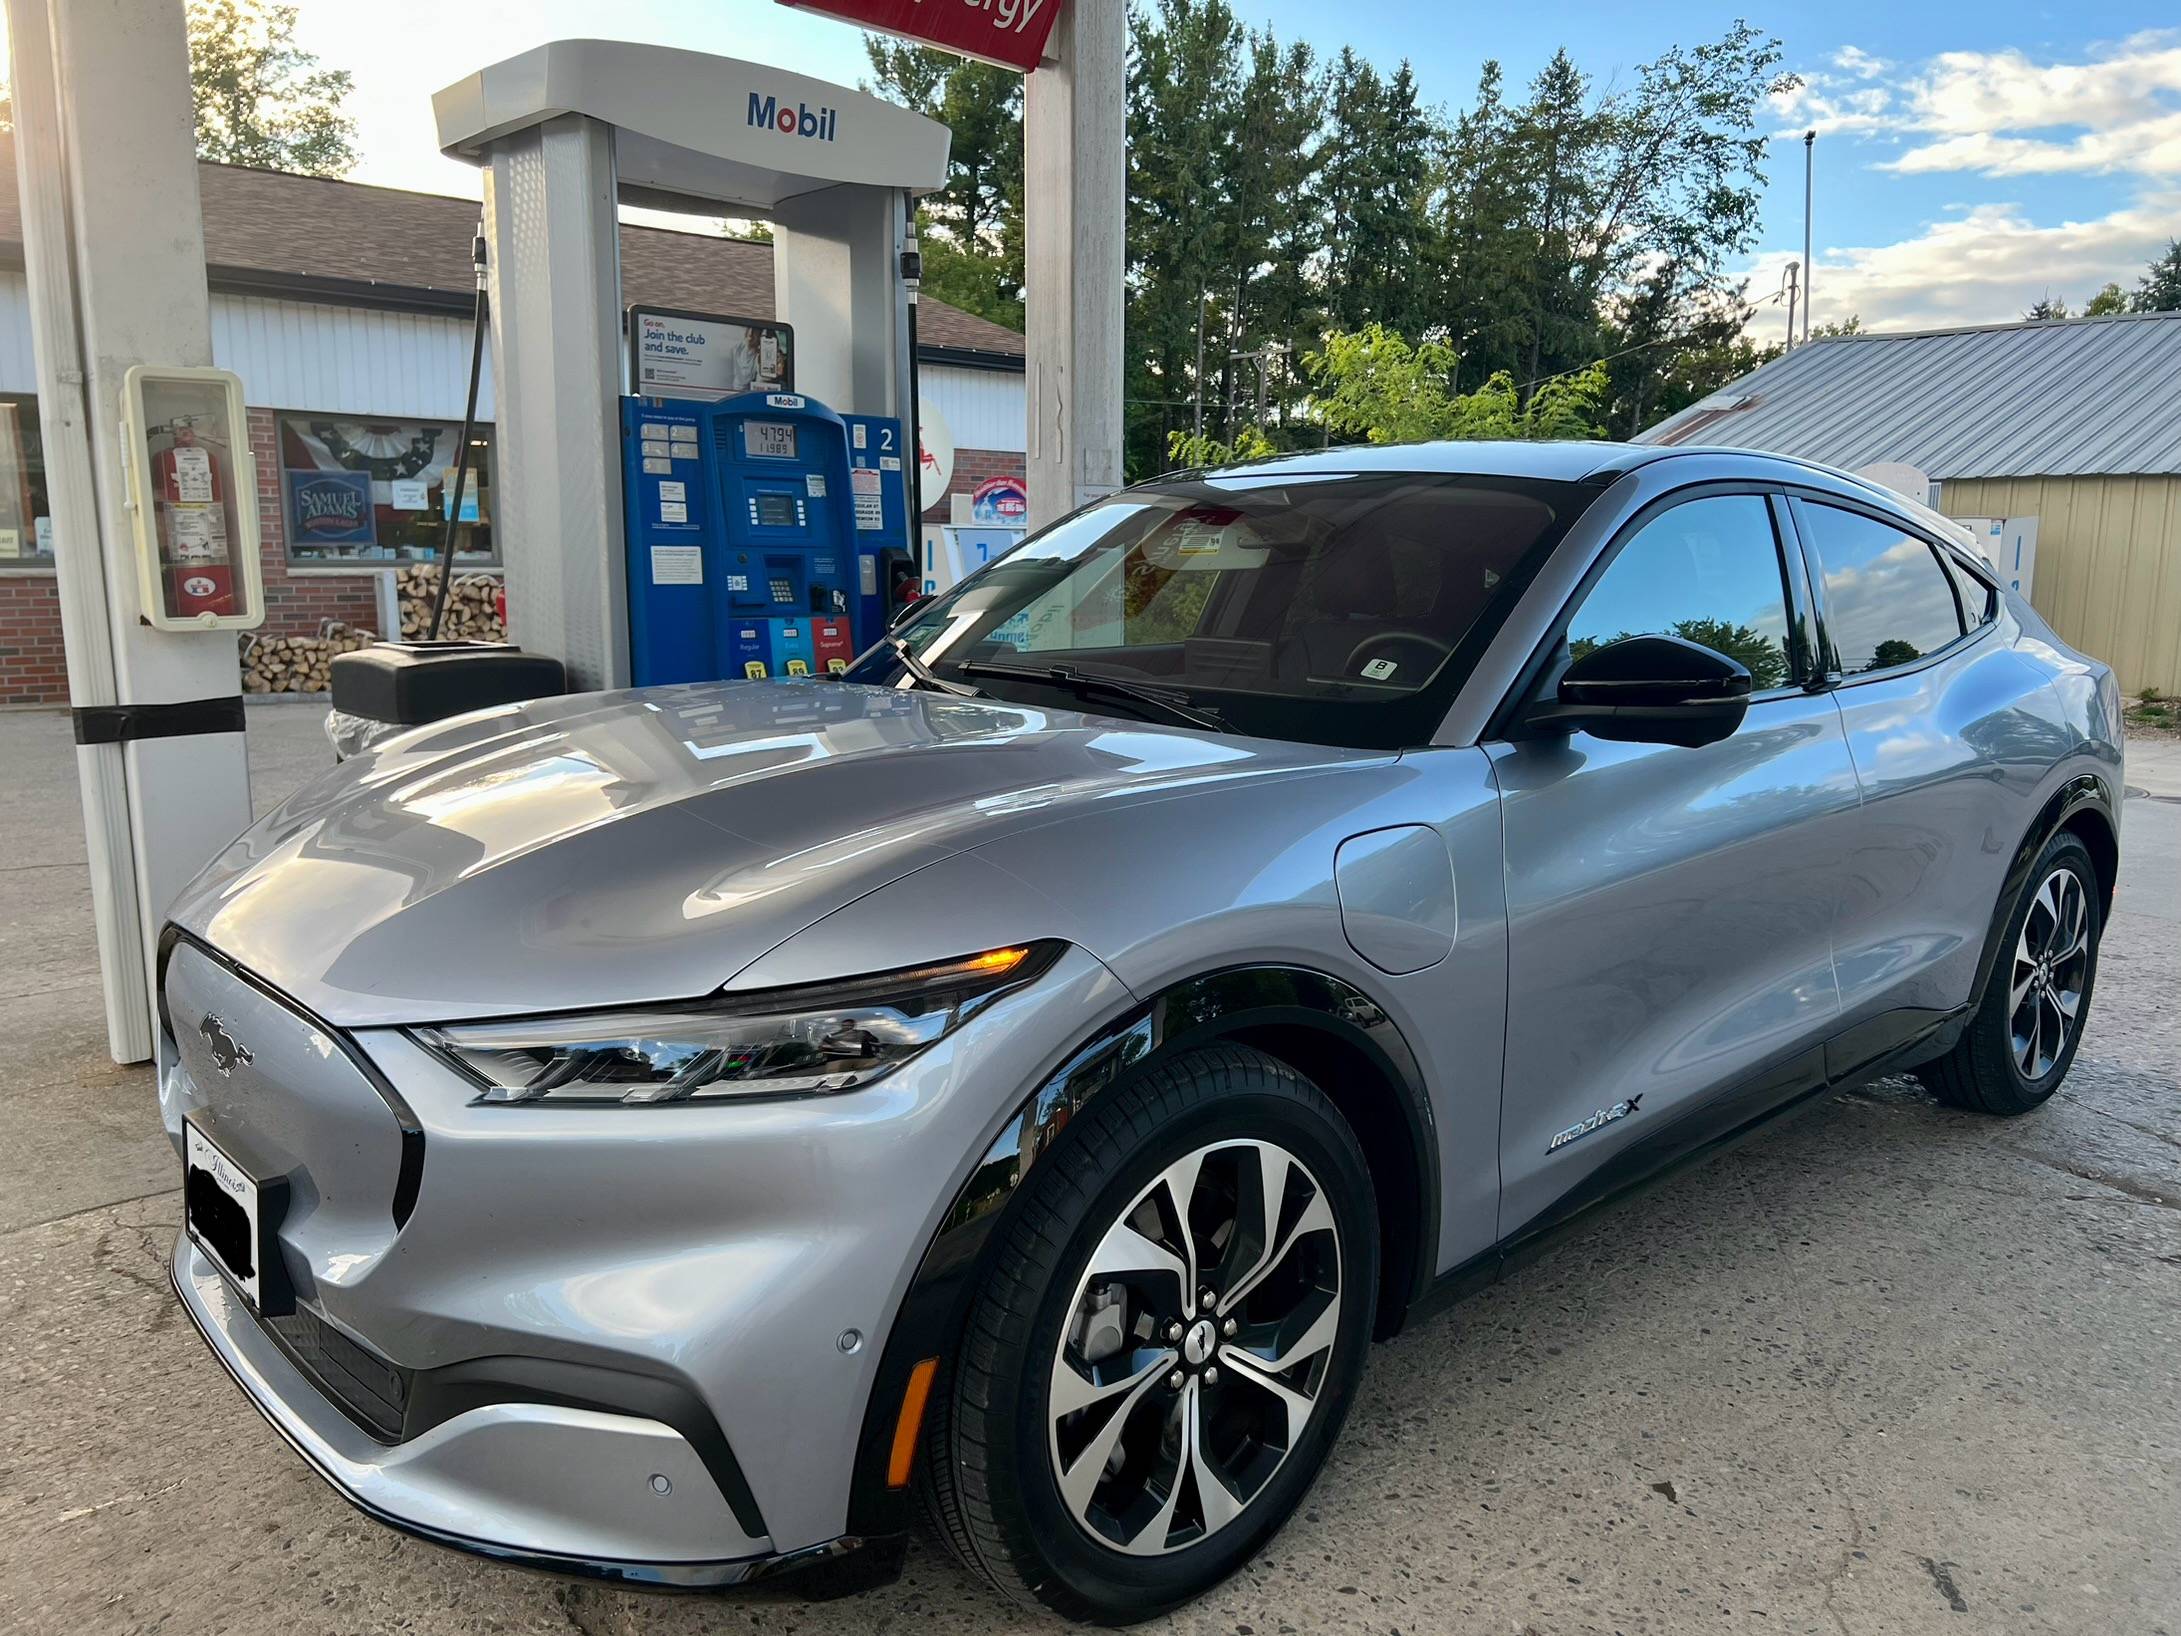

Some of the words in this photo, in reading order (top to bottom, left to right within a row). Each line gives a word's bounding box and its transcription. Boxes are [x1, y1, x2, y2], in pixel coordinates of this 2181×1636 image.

[747, 92, 836, 142] Mobil
[644, 329, 665, 340] Join
[667, 331, 684, 342] the
[685, 333, 706, 345] club
[644, 342, 663, 352] and
[665, 345, 689, 355] save.
[774, 396, 798, 407] Mobil
[880, 428, 893, 451] 2
[301, 490, 361, 508] SAMUEL
[306, 503, 358, 519] ADAMS
